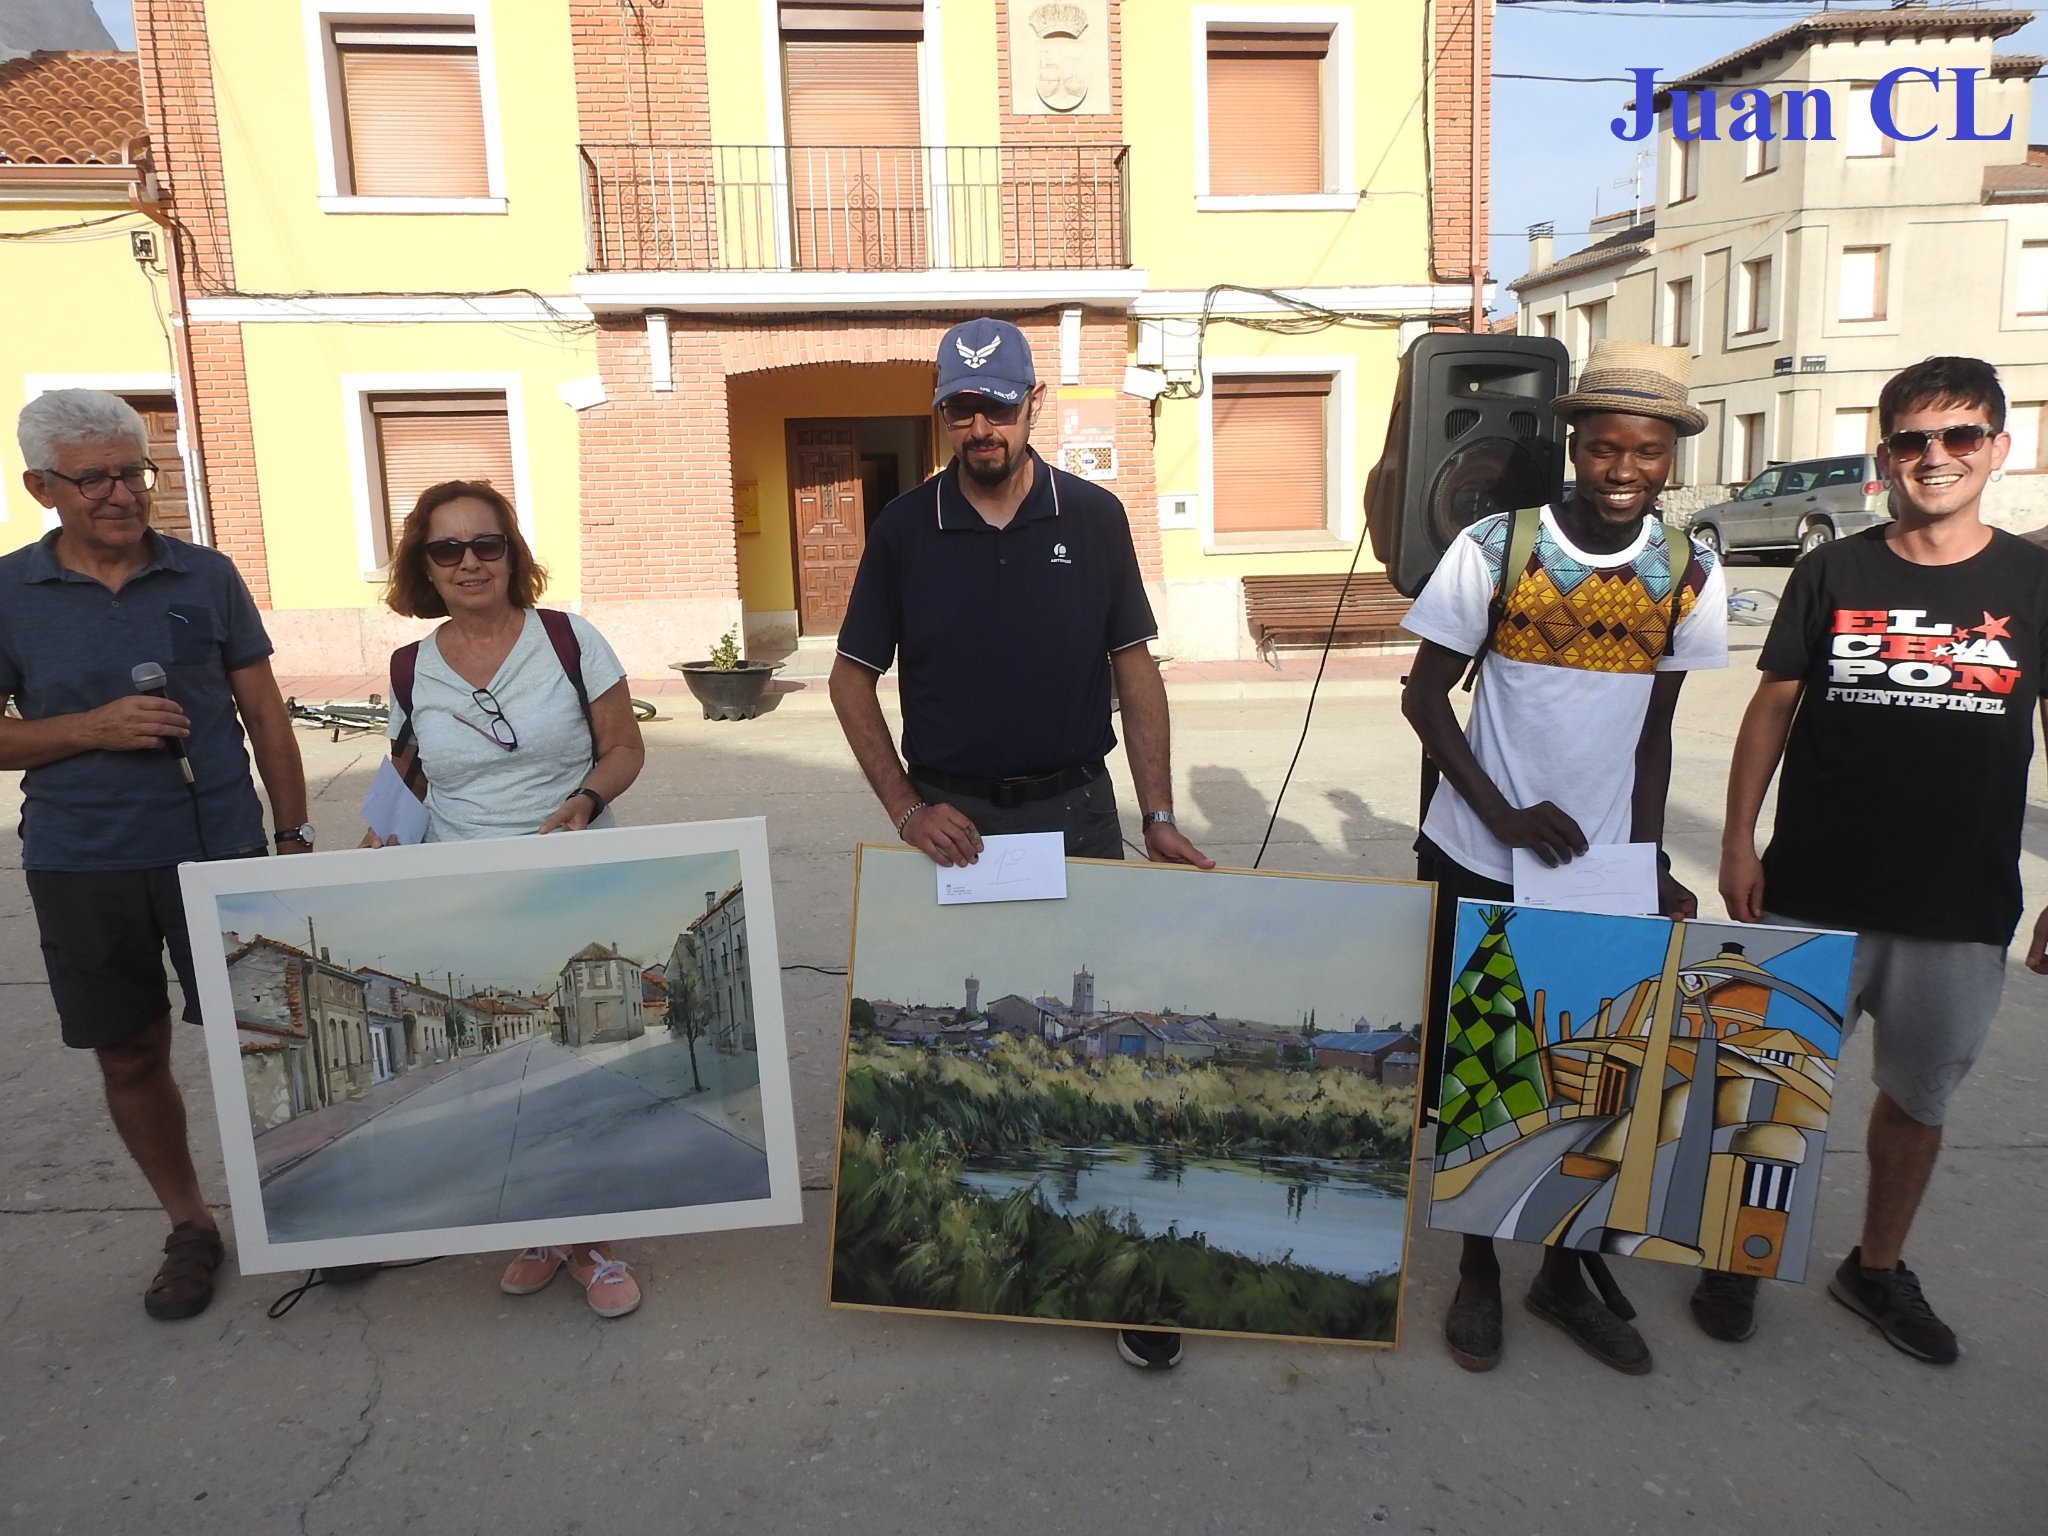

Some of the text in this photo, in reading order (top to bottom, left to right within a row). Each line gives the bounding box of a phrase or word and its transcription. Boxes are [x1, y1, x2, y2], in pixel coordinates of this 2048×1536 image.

[1830, 609, 1953, 636] EL
[1828, 659, 2022, 694] PON
[1826, 687, 2006, 715] FUENTEPIÑEL
